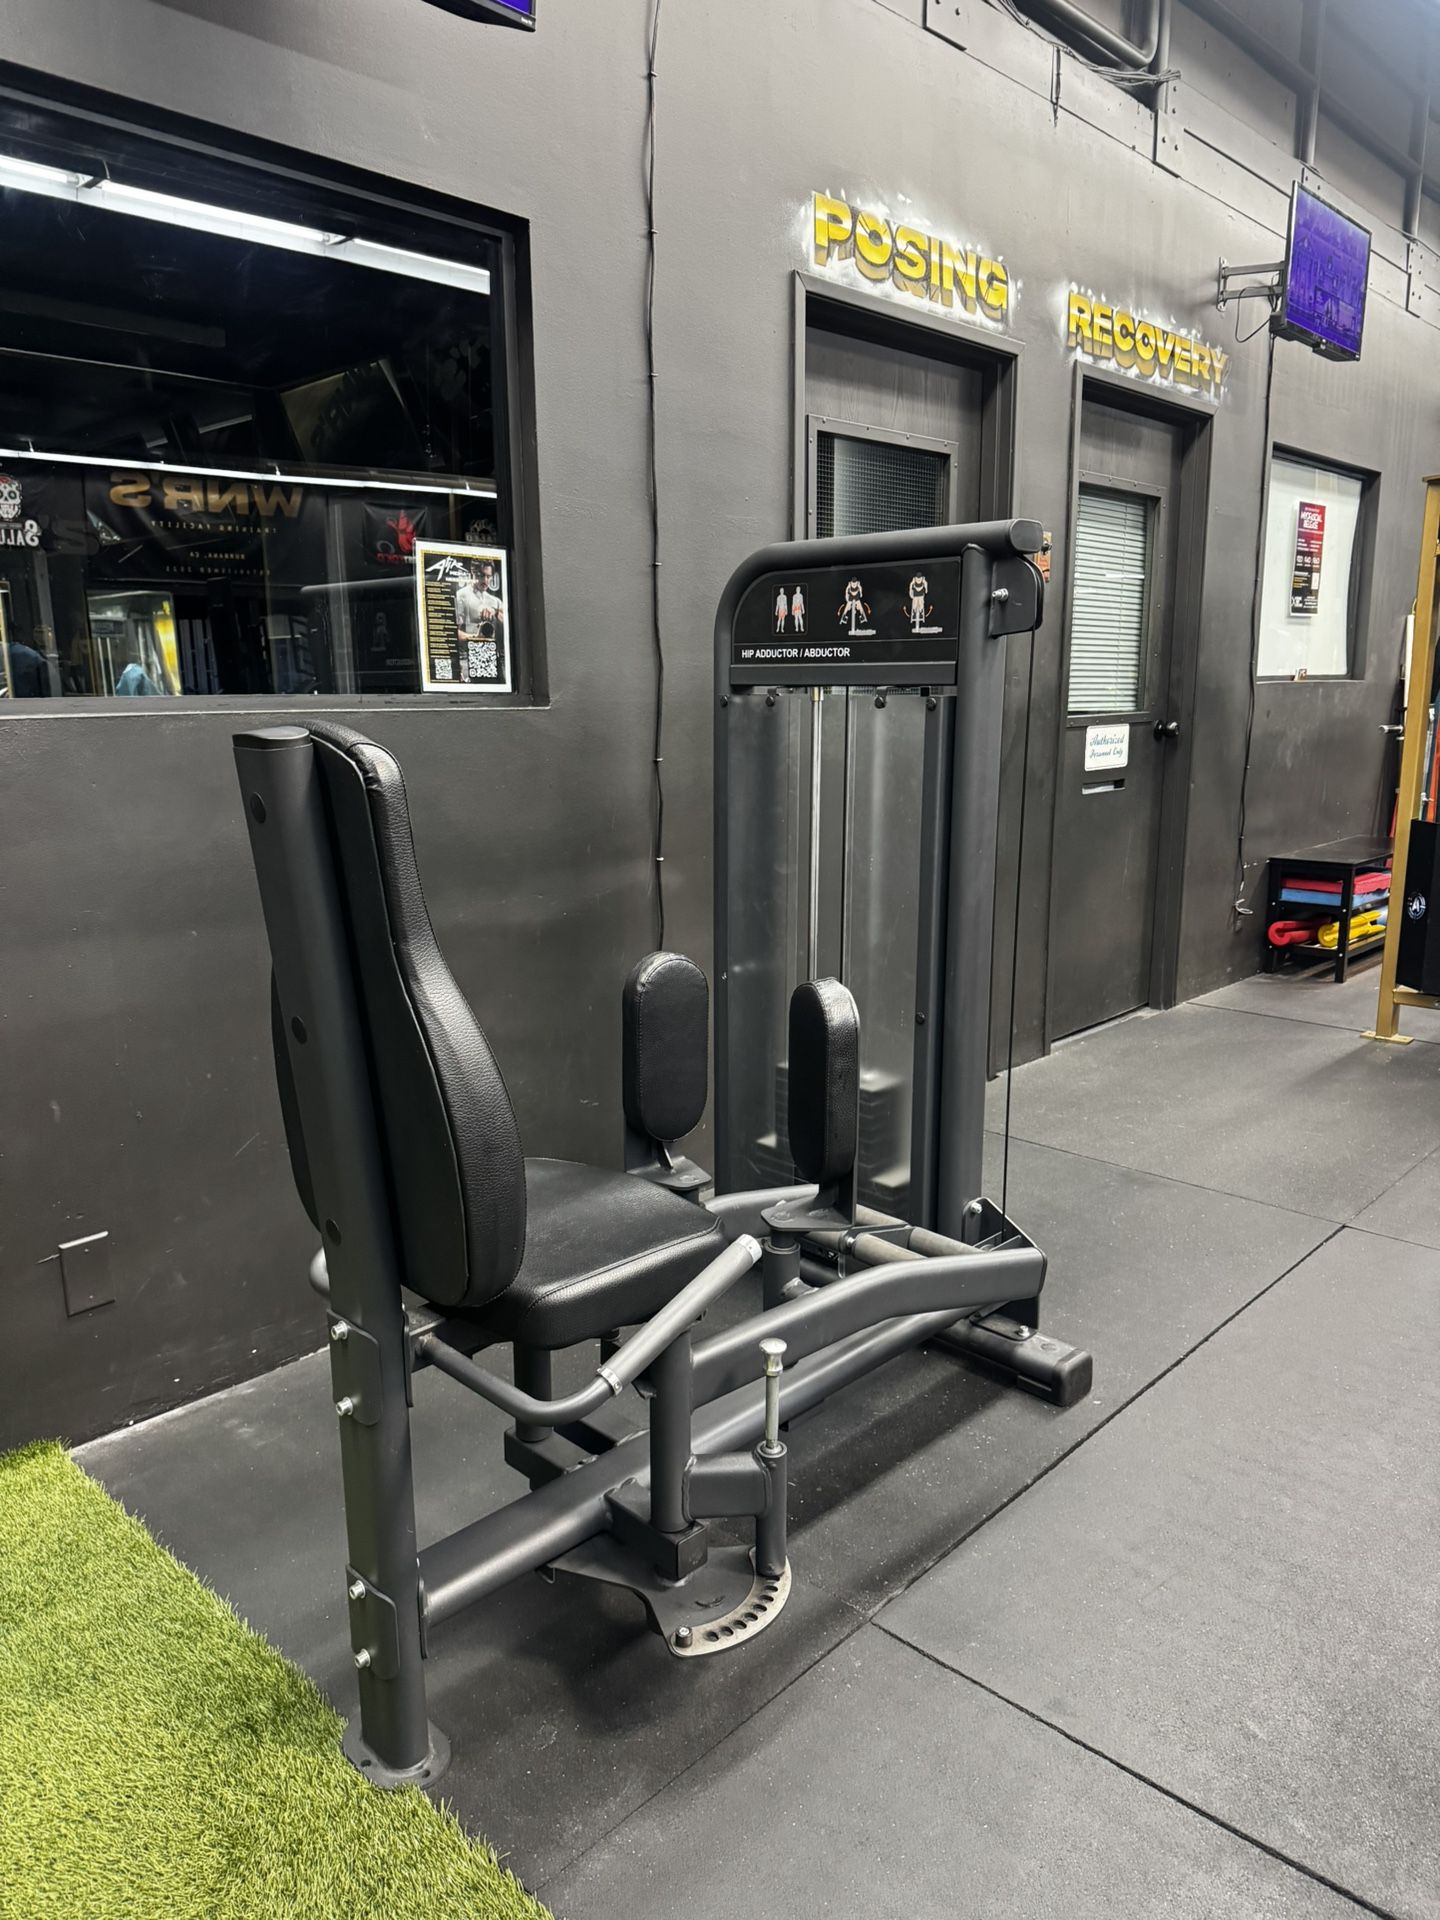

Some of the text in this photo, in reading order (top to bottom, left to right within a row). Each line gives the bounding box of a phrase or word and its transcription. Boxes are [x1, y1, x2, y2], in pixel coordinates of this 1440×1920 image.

[811, 191, 1009, 322] POSING
[1068, 292, 1228, 393] RECOVERY
[741, 649, 755, 659] HIP
[755, 648, 799, 659] ADDUCTOR
[804, 647, 851, 658] ABDUCTOR
